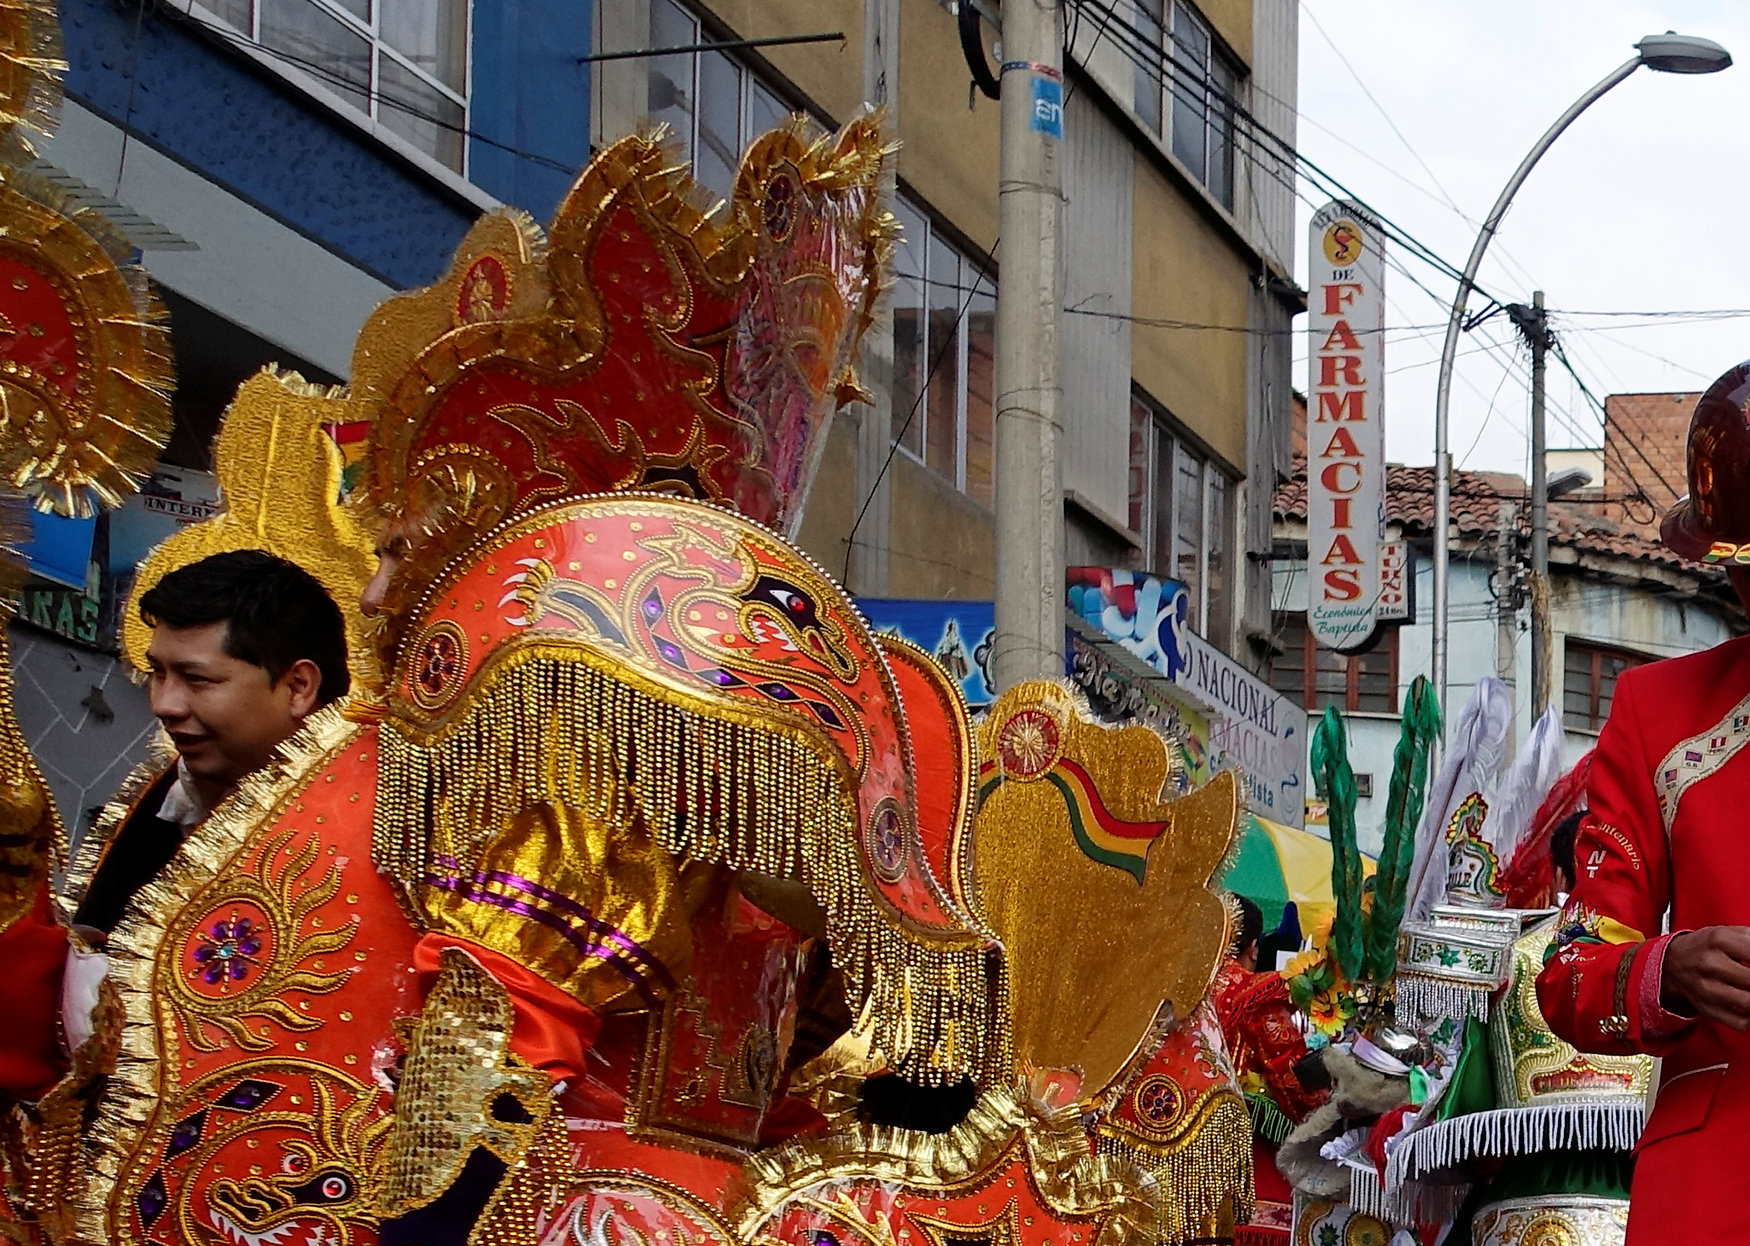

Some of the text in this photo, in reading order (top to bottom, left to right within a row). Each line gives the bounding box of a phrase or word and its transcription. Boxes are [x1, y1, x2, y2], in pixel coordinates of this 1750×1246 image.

[1332, 269, 1355, 281] DE
[1315, 284, 1368, 602] FARMACIAS
[1198, 650, 1280, 737] NACIONAL
